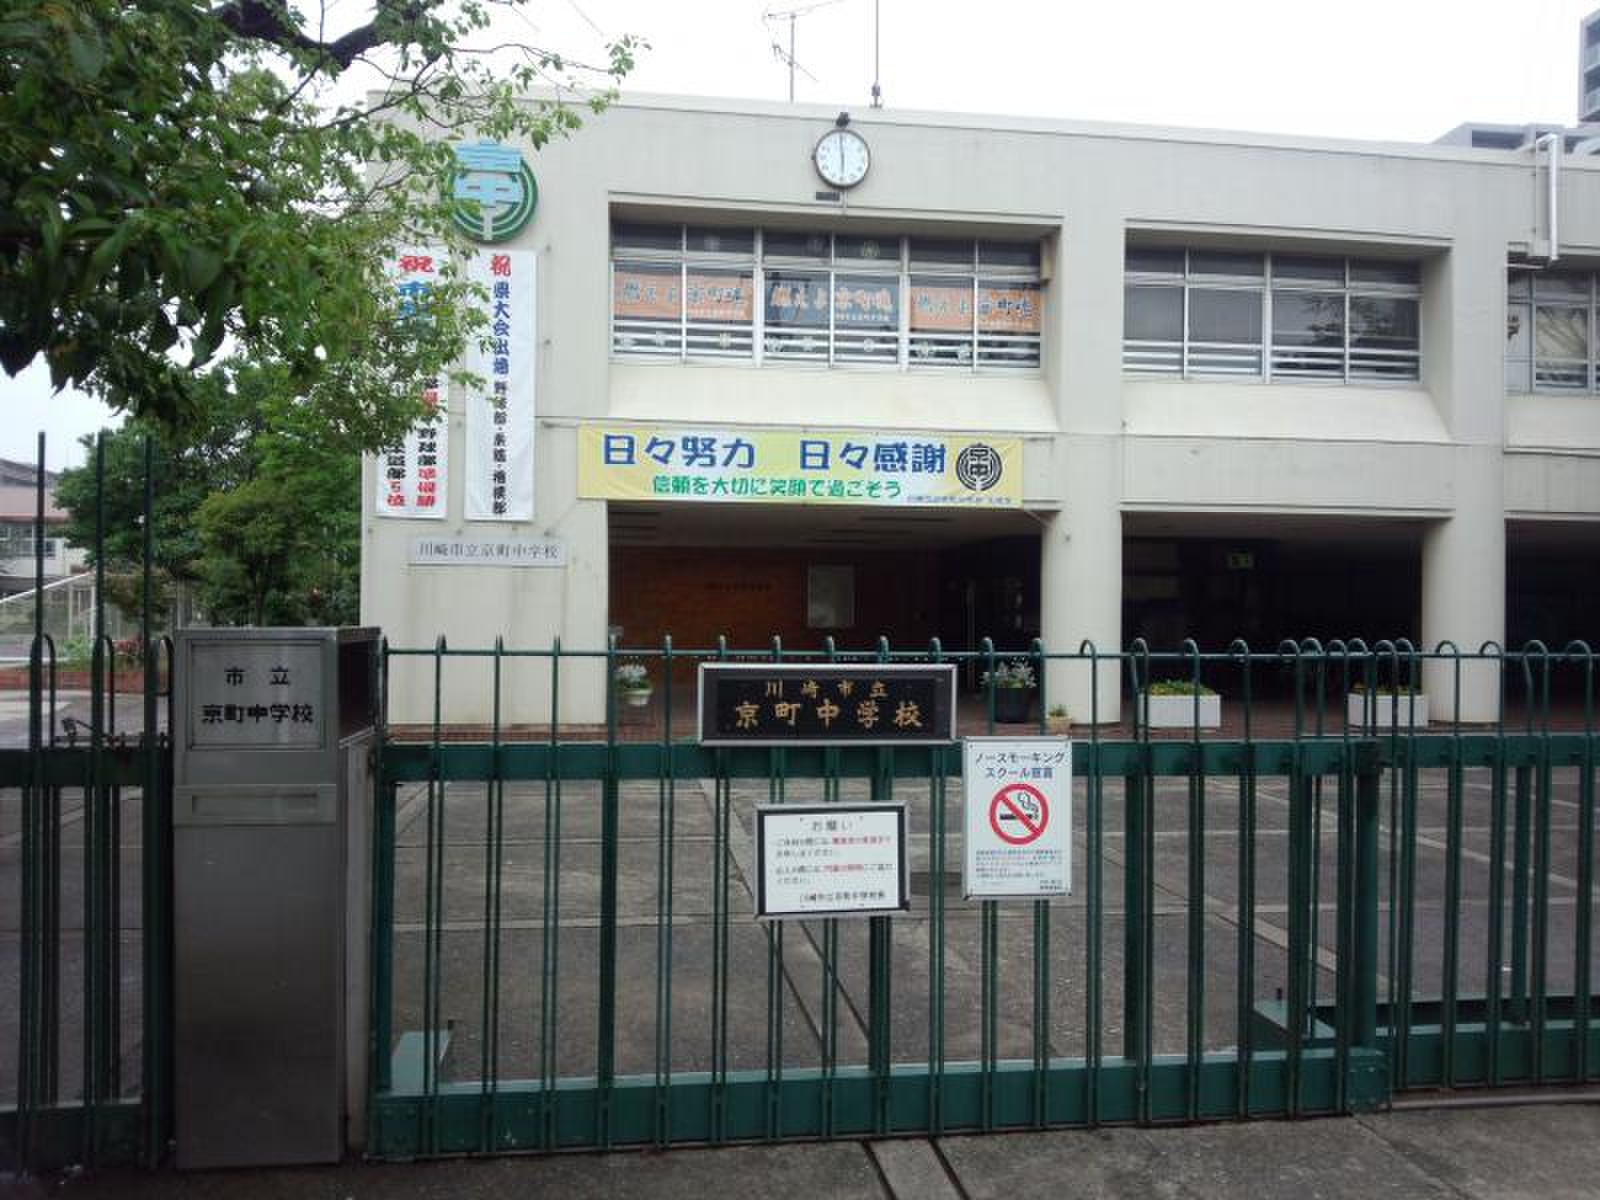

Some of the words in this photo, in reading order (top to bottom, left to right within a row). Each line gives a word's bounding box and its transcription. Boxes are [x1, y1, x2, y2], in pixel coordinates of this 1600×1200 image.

[490, 254, 511, 276] 祝
[603, 434, 755, 469] 日々努力
[800, 440, 946, 474] 日々感謝
[652, 475, 902, 498] 信頼を大切に笑顔で過ごそう
[418, 541, 560, 559] 川崎市立京町中学校
[224, 666, 291, 686] 市立
[766, 679, 889, 699] 川崎市立
[201, 703, 313, 724] 京町中学校
[735, 699, 923, 729] 京町中学校
[975, 752, 1066, 764] ノースモーキング
